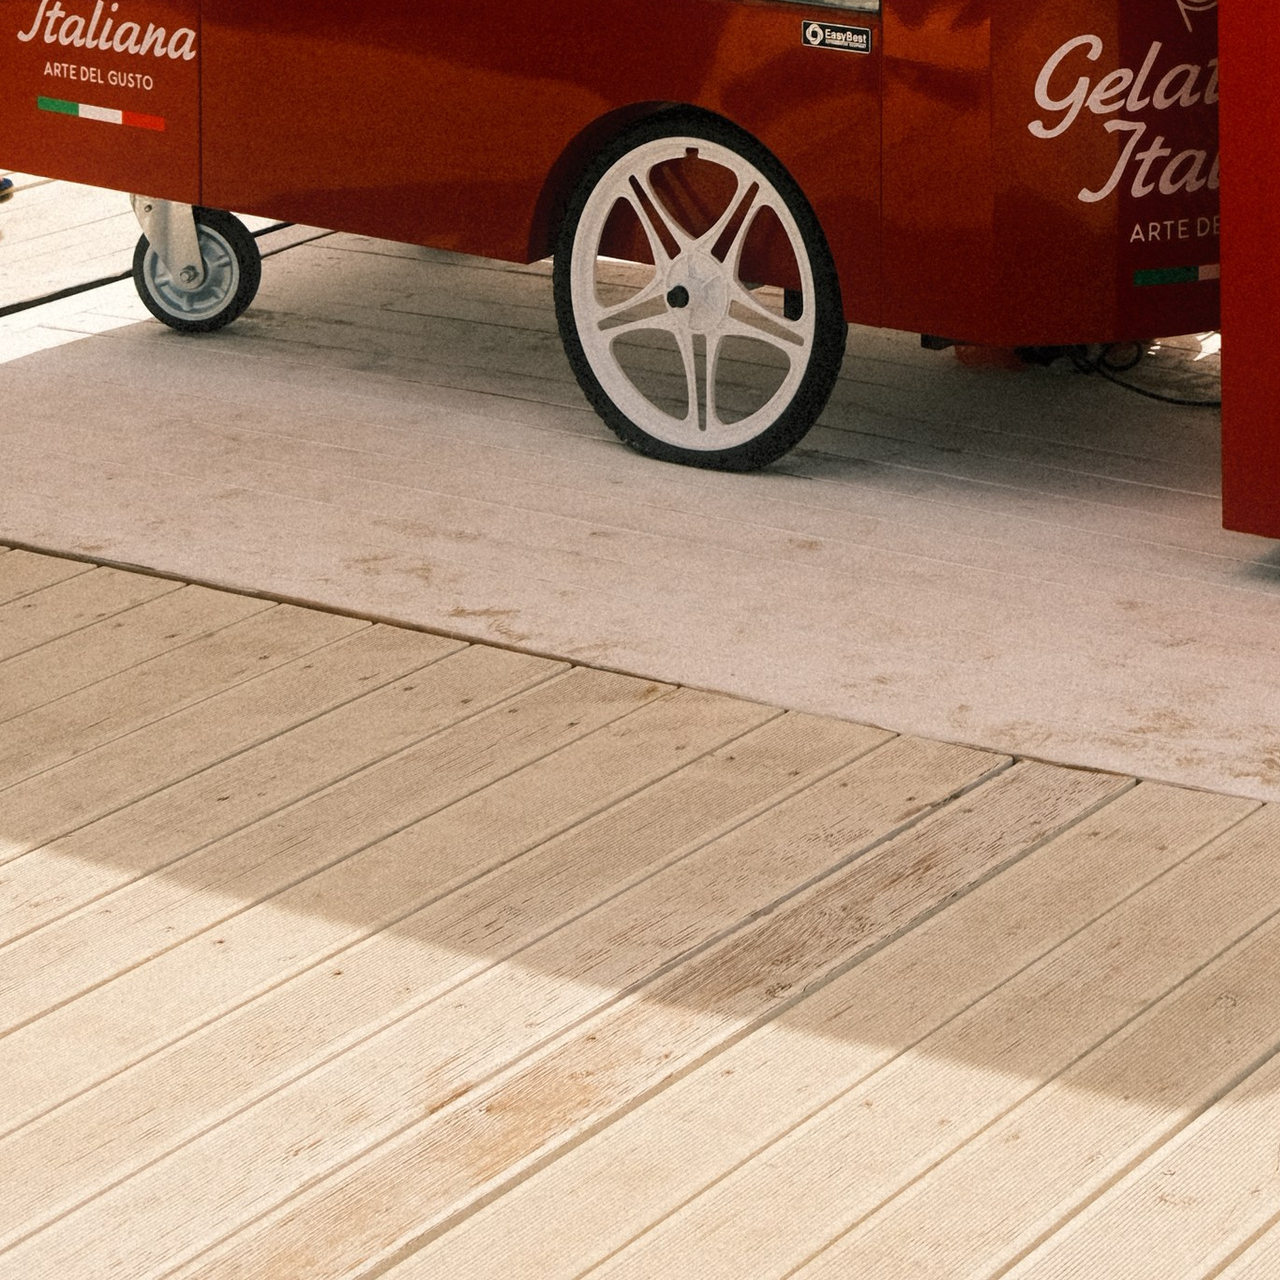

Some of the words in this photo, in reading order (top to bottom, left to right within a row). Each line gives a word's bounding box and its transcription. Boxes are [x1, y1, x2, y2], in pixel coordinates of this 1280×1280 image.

[825, 28, 867, 43] EasyBest
[43, 61, 77, 81] ARTE
[79, 66, 104, 84] DEL
[107, 69, 154, 91] GUSTO
[1129, 218, 1190, 244] ARTE
[1197, 215, 1220, 236] DE
